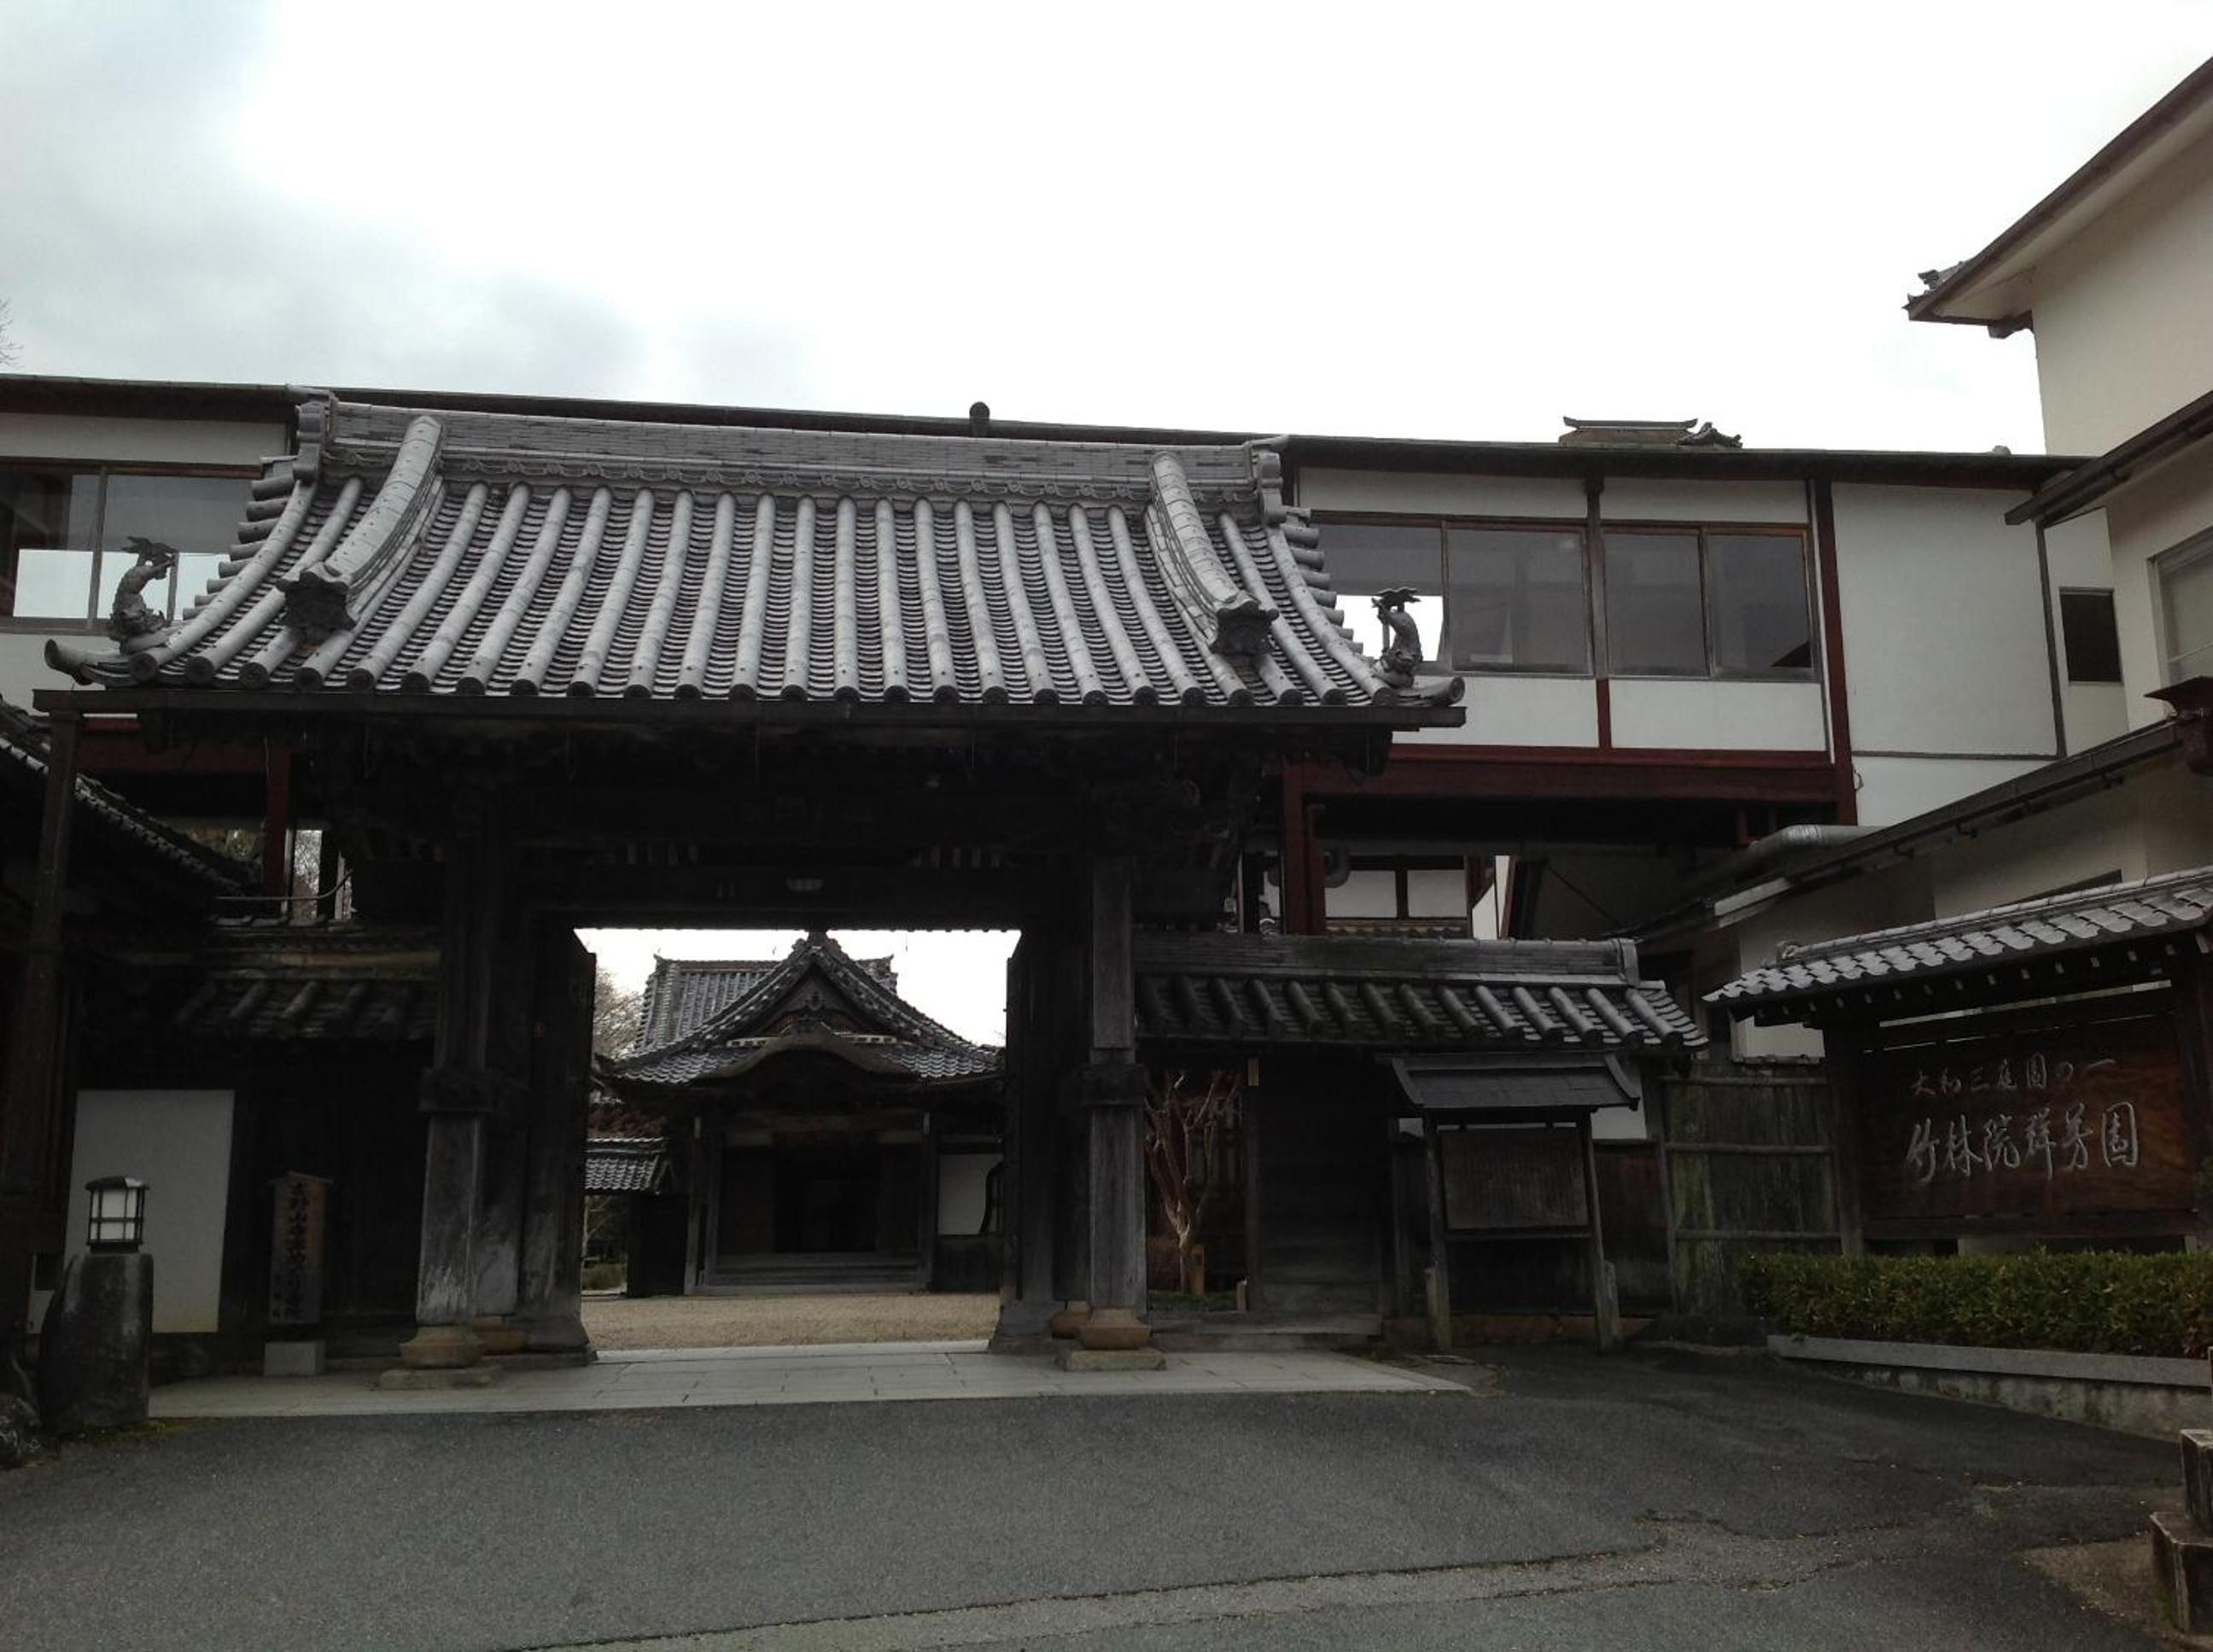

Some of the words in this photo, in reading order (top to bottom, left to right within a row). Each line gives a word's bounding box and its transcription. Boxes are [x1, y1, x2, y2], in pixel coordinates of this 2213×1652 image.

[1906, 1100, 2138, 1184] 竹林院群芳園
